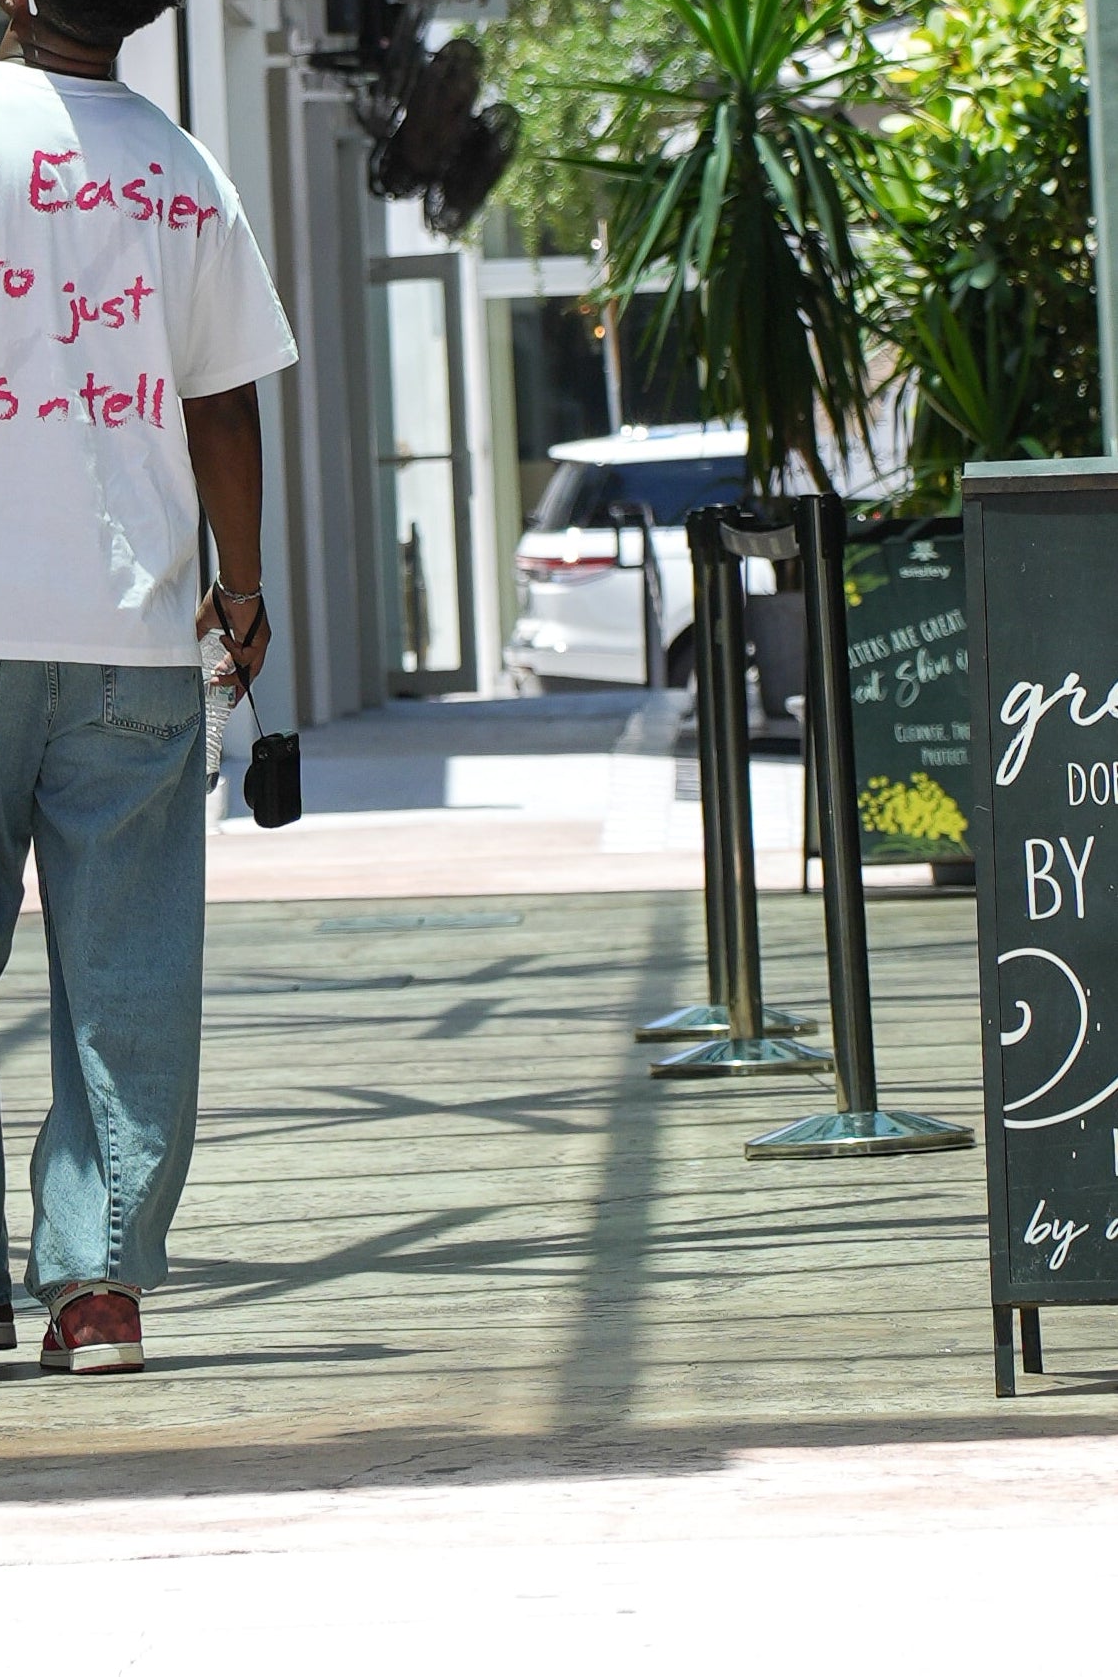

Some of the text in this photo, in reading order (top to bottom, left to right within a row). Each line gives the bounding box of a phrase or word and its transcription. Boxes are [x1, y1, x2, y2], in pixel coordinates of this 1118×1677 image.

[27, 149, 223, 238] Easier
[48, 275, 155, 345] just
[79, 371, 166, 429] tell
[890, 625, 921, 654] ARE
[919, 608, 968, 643] GREAT
[995, 671, 1118, 787] gr
[1024, 835, 1095, 921] BY
[1023, 1199, 1090, 1271] by
